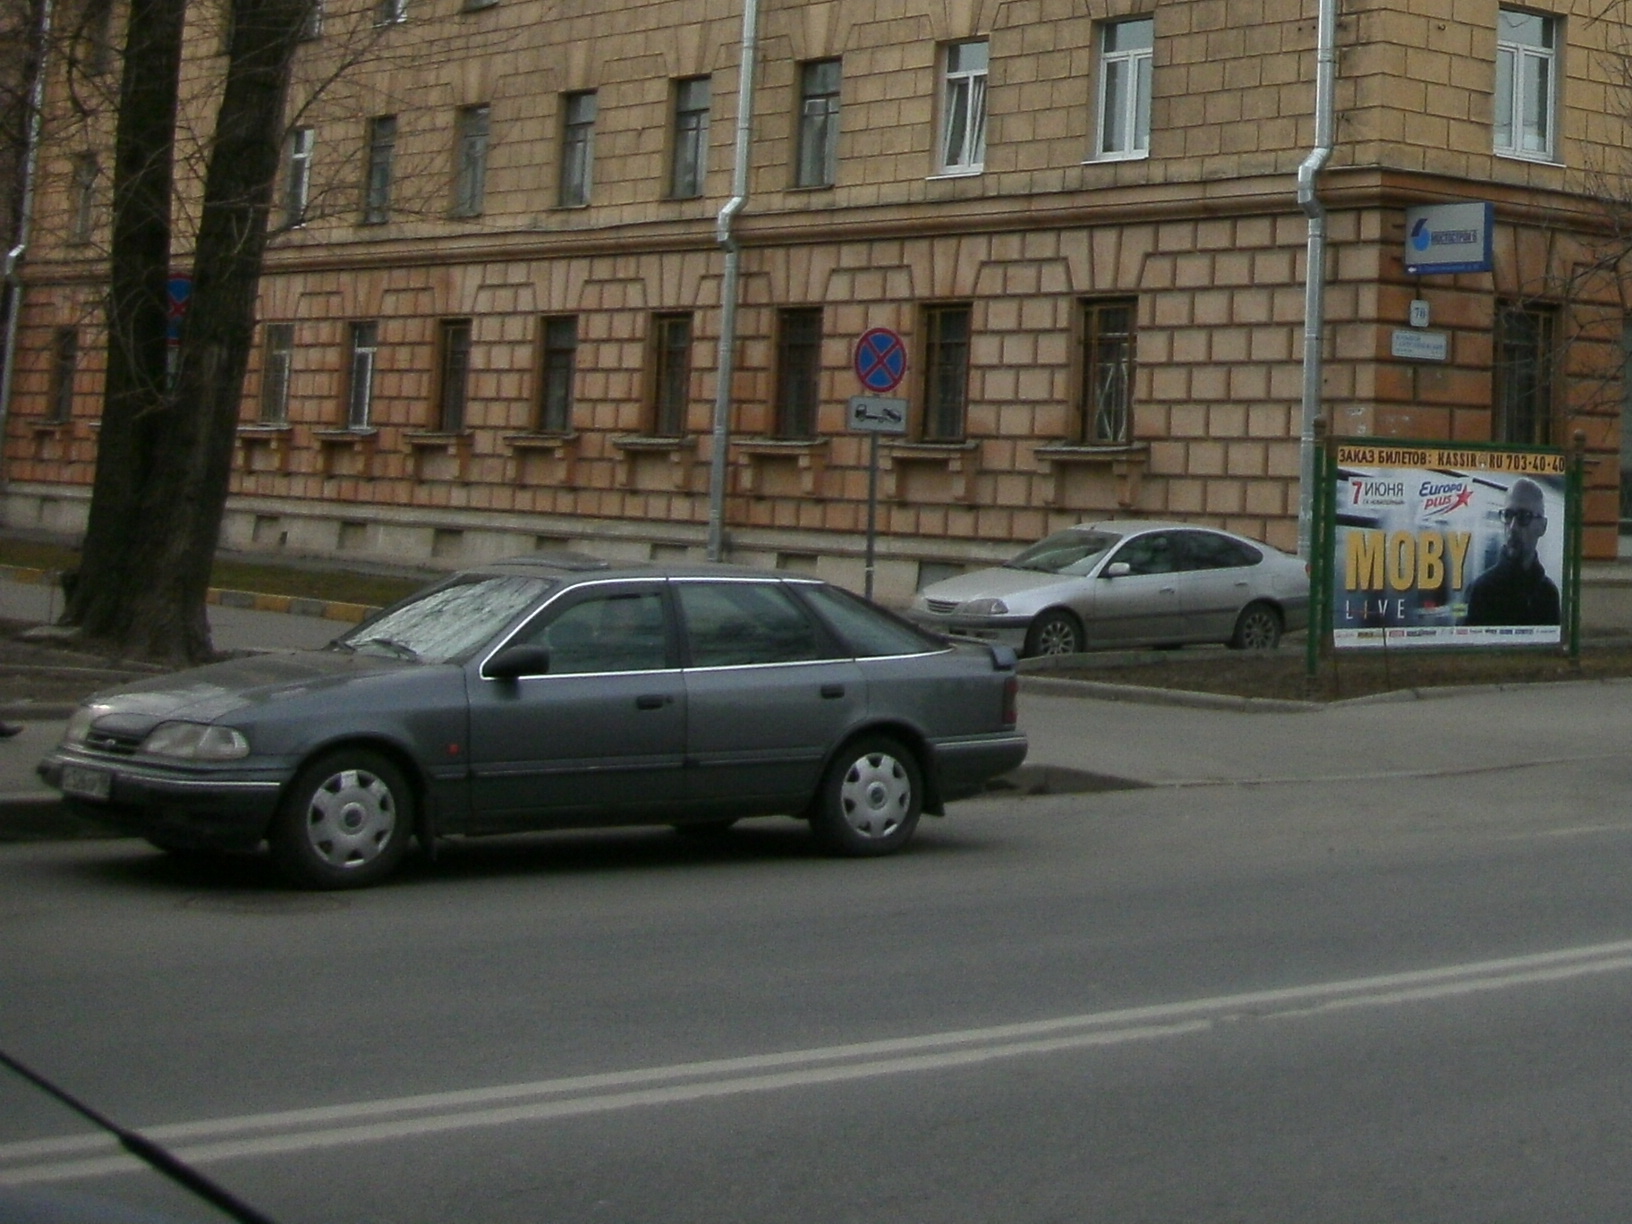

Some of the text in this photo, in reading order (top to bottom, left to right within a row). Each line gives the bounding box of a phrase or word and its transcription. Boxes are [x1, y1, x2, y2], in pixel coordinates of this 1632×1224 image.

[1339, 448, 1375, 464] ЗАКАЗ
[1378, 450, 1433, 466] БИЛЕТОВ:
[1352, 481, 1405, 505] 7 ИЮНЯ
[1345, 530, 1471, 592] MOBY
[1346, 598, 1406, 620] LIVE
